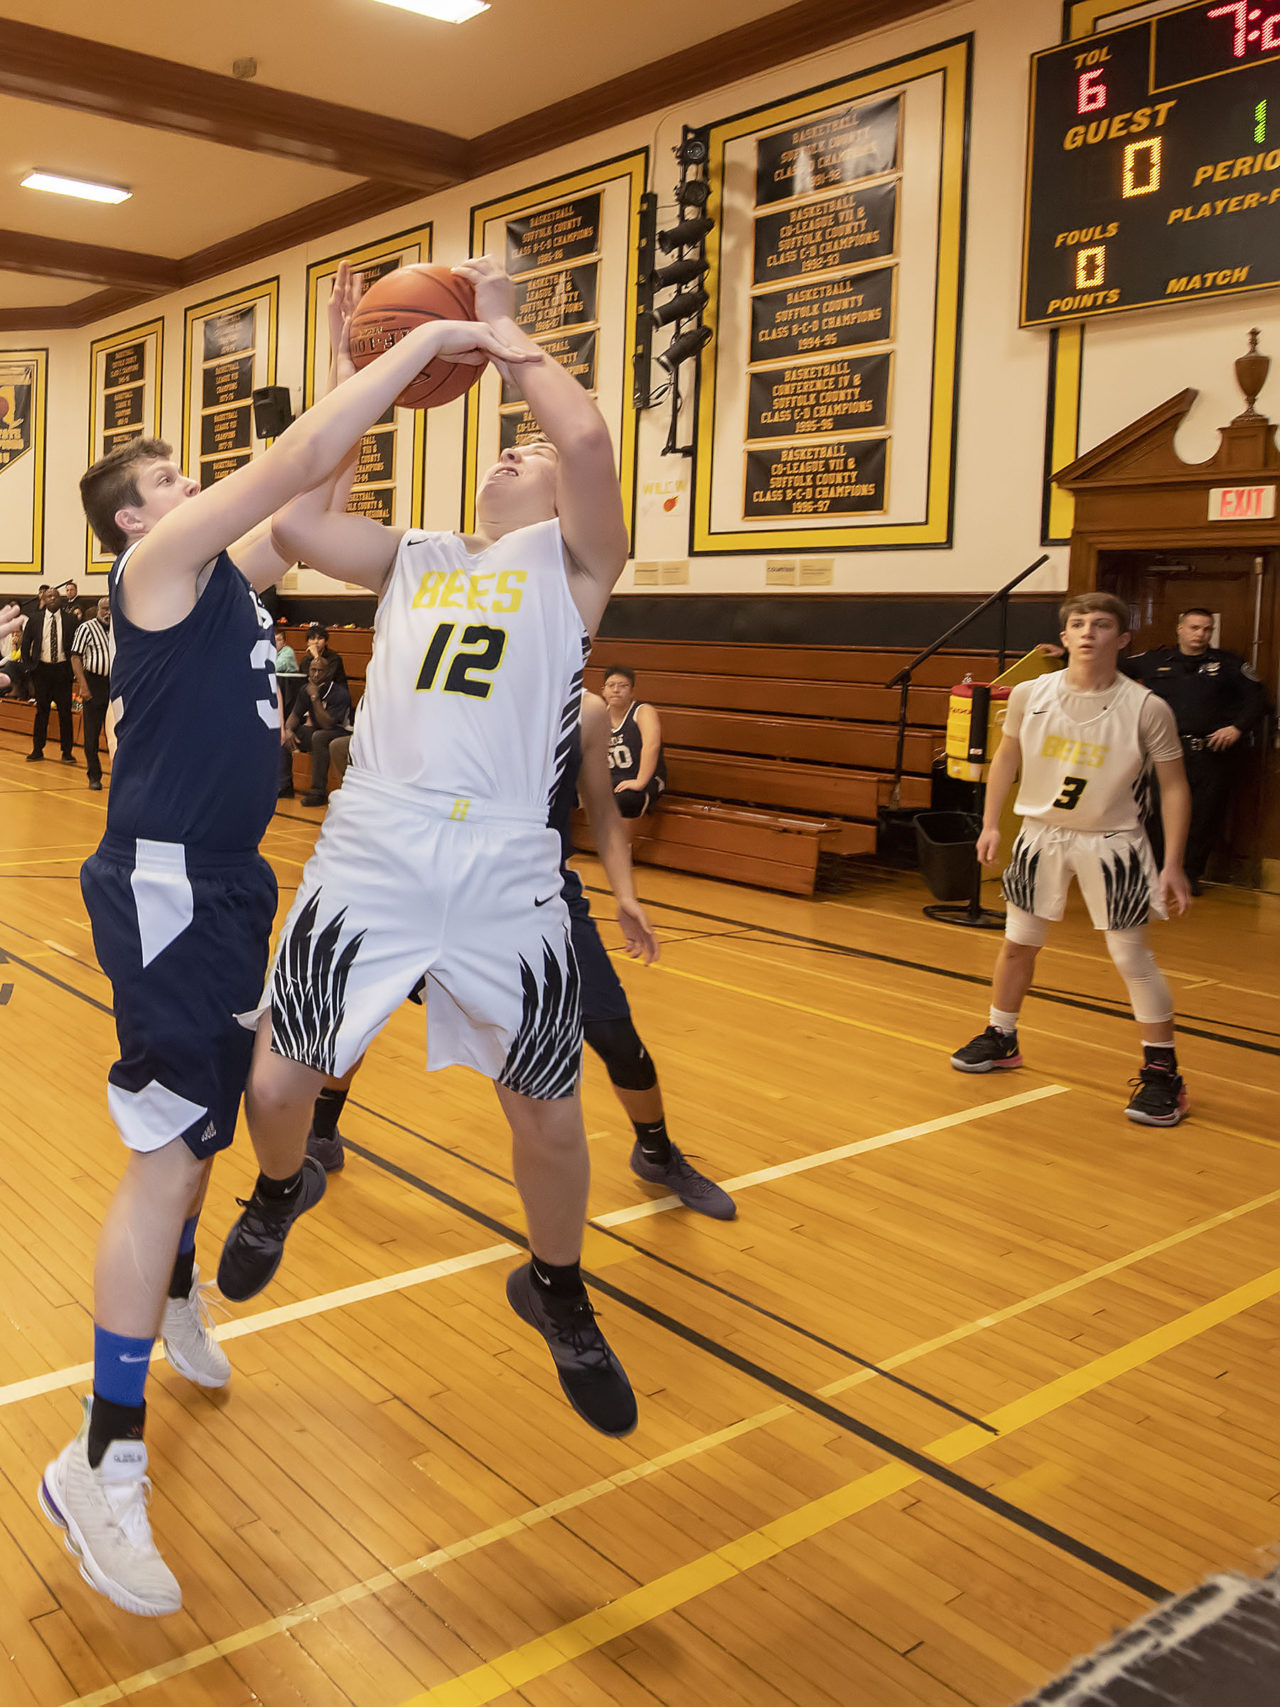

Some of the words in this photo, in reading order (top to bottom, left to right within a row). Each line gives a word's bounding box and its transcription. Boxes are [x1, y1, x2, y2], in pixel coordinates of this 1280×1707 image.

[1074, 45, 1112, 70] TOL
[1078, 68, 1107, 114] 6
[792, 113, 859, 144] BASKETBALL
[1063, 100, 1178, 151] GUEST
[1253, 99, 1267, 145] 1
[1122, 136, 1162, 199] 0
[529, 205, 575, 228] BASKETBALL
[789, 195, 857, 223] BASKETBALL
[522, 226, 552, 244] SUFFOLK
[553, 216, 583, 234] COUNTY
[553, 226, 594, 248] CHAMPIONS
[778, 231, 823, 252] SUFFOLK
[825, 219, 868, 240] COUNTY
[779, 215, 835, 239] CO-LEAGUE
[839, 210, 853, 222] VII
[1054, 222, 1120, 249] FOULS
[766, 249, 797, 268] CLASS
[819, 230, 880, 254] CHAMPIONS
[1076, 245, 1106, 290] 0
[1165, 265, 1251, 295] MATCH
[519, 297, 549, 315] SUFFOLK
[786, 280, 854, 306] BASKETBALL
[1046, 288, 1120, 314] POINTS
[775, 303, 820, 323] SUFFOLK
[822, 294, 864, 314] COUNTY
[758, 326, 790, 342] CLASS
[791, 319, 819, 337] B-C-D
[822, 307, 882, 330] CHAMPIONS
[772, 377, 835, 397] CONFERENCE
[838, 375, 852, 389] IV
[784, 362, 851, 382] BASKETBALL
[760, 410, 792, 424] CLASS
[793, 406, 812, 420] C-D
[813, 400, 873, 419] CHAMPIONS
[772, 392, 817, 410] SUFFOLK
[820, 387, 861, 404] COUNTY
[771, 460, 825, 476] CO-LEAGUE
[828, 458, 844, 471] VII
[780, 444, 848, 462] BASKETBALL
[752, 490, 784, 503] CLASS
[785, 487, 812, 501] B-C-D
[815, 483, 876, 500] CHAMPIONS
[769, 474, 814, 489] SUFFOLK
[816, 471, 859, 485] COUNTY
[1220, 488, 1266, 518] EXIT
[411, 568, 528, 614] BEES
[415, 621, 509, 700] 12
[1039, 734, 1111, 769] BEES
[1052, 776, 1088, 811] 3
[450, 798, 471, 821] B
